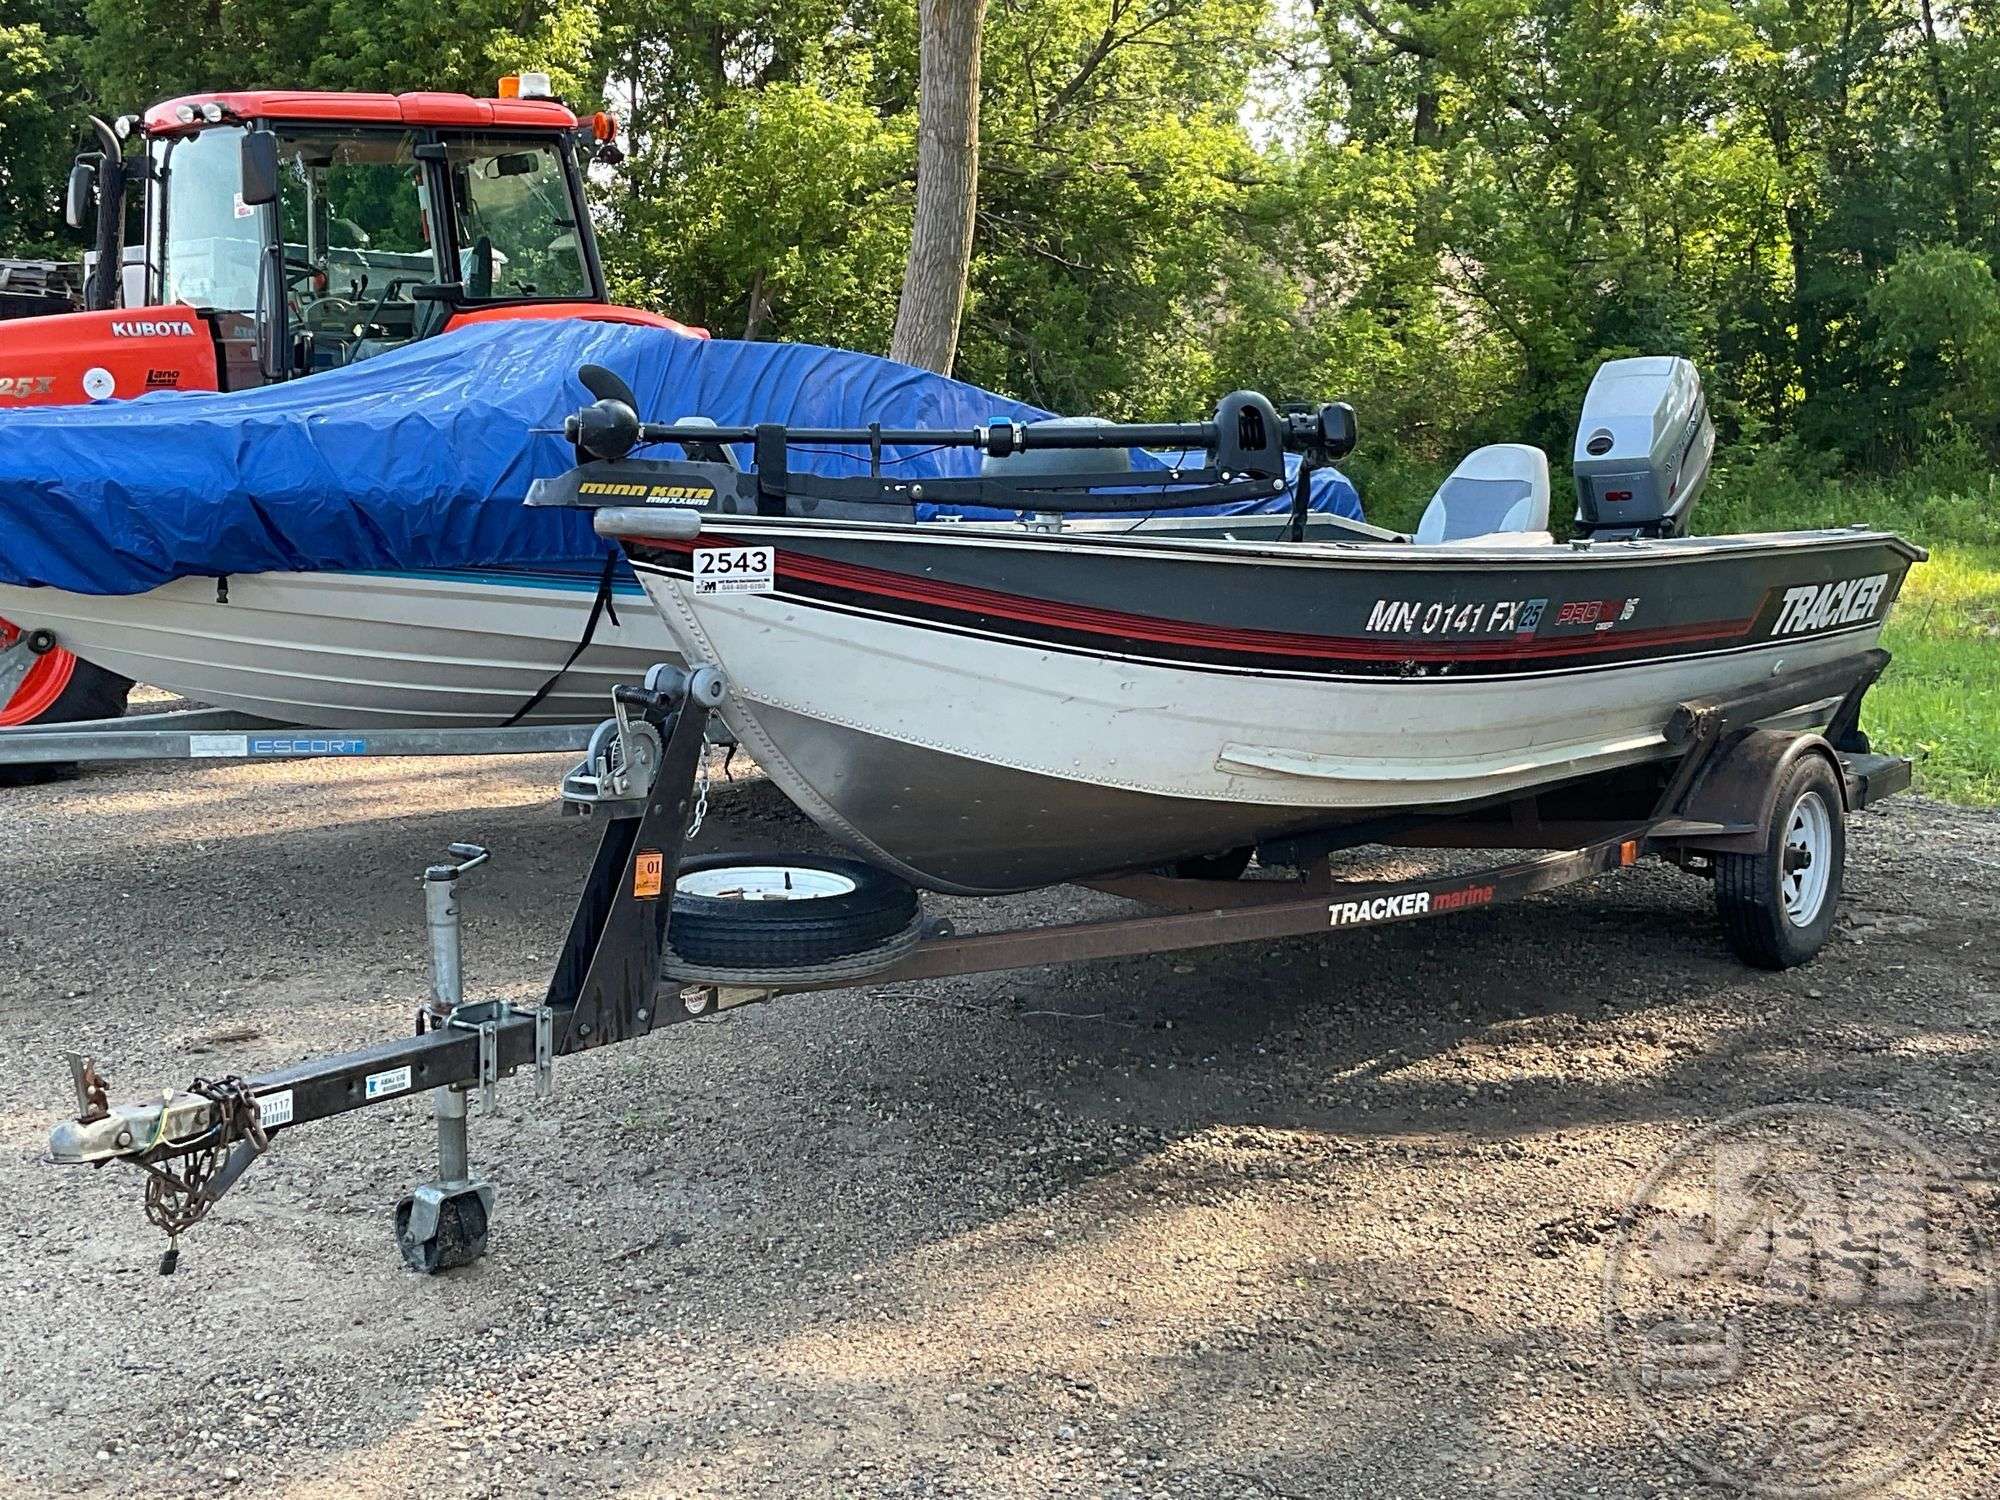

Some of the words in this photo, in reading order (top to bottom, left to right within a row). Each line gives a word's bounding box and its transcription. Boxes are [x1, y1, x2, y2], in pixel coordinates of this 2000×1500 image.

[111, 321, 195, 336] KUBOTA
[650, 486, 714, 499] KOTA
[700, 551, 767, 574] 2543
[1770, 574, 1888, 635] TRACKER
[1366, 600, 1421, 632] MN
[1422, 602, 1485, 634] 0141
[1486, 602, 1525, 632] FX
[1519, 605, 1543, 626] 25
[255, 740, 362, 752] ESCORT
[647, 861, 660, 874] 01
[1329, 892, 1430, 926] TRACKER
[1433, 884, 1493, 910] marine
